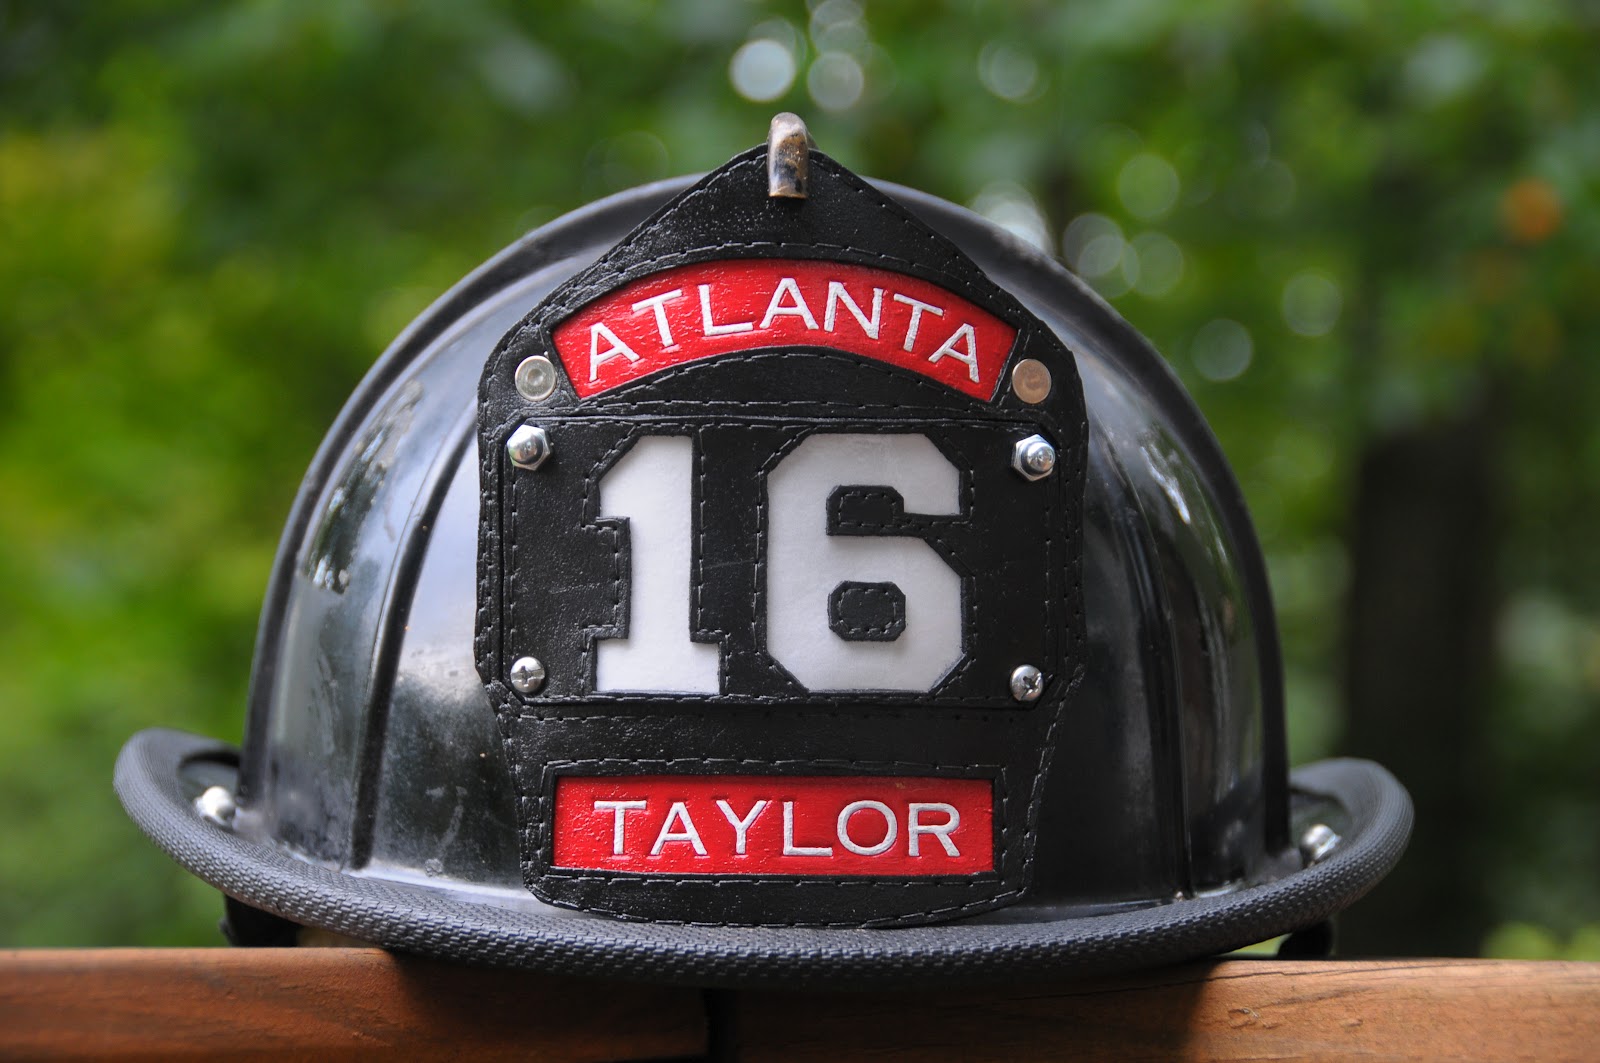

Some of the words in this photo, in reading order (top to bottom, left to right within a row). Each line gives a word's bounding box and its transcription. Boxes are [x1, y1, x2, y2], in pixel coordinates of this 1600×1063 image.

[588, 277, 981, 384] ATLANTA
[595, 432, 964, 696] 16
[593, 799, 961, 857] TAYLOR
